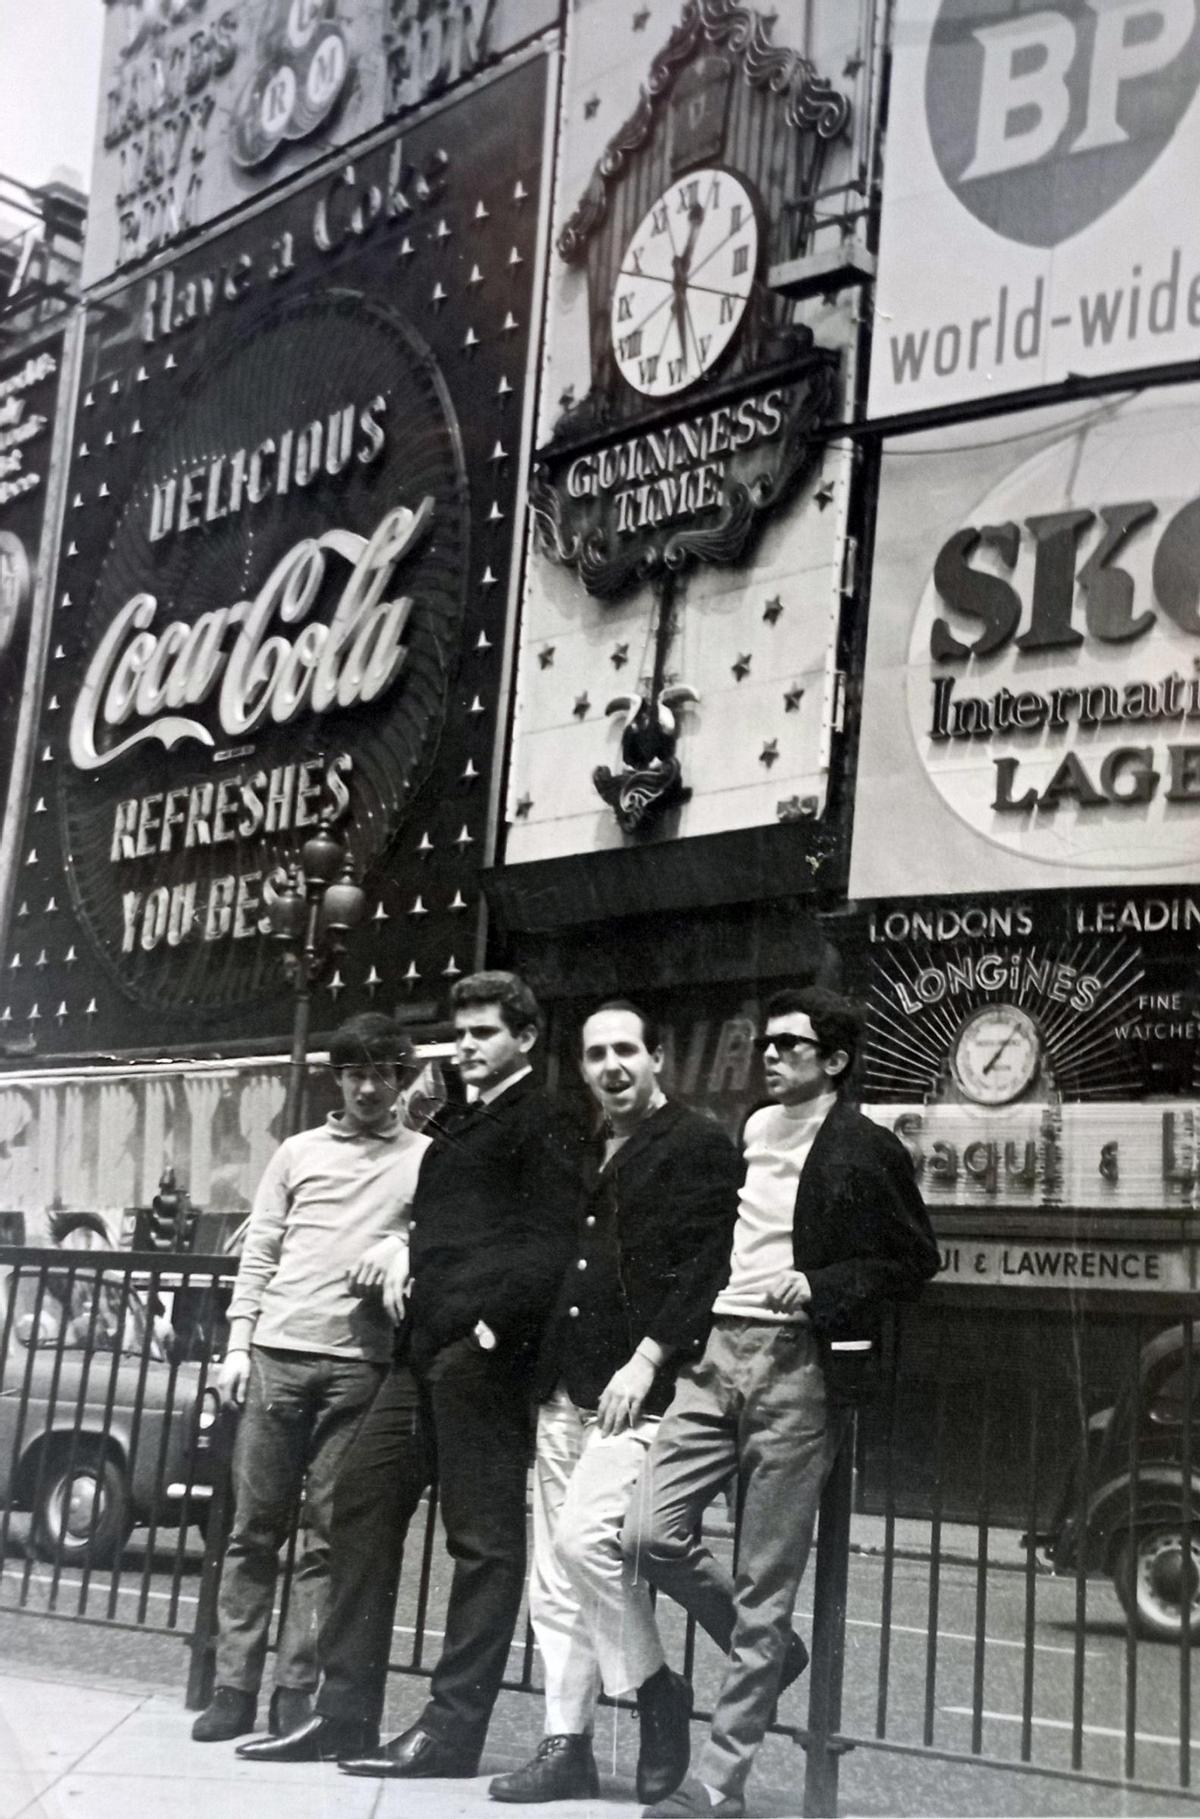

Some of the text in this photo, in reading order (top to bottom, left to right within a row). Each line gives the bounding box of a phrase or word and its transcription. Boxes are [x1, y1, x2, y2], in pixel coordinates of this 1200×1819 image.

[958, 0, 1196, 183] BP
[149, 395, 387, 543] DELICIOUS
[567, 390, 782, 498] GUINNESS
[615, 460, 725, 533] TIME
[110, 753, 353, 863] REFRESHES
[990, 743, 1200, 812] LAGE
[122, 882, 197, 953] YOU
[869, 897, 1200, 943] LONDONS LEADIN
[1114, 1022, 1200, 1040] WATCHE
[1138, 993, 1181, 1010] FINE
[1002, 1250, 1160, 1280] LAWRENCE
